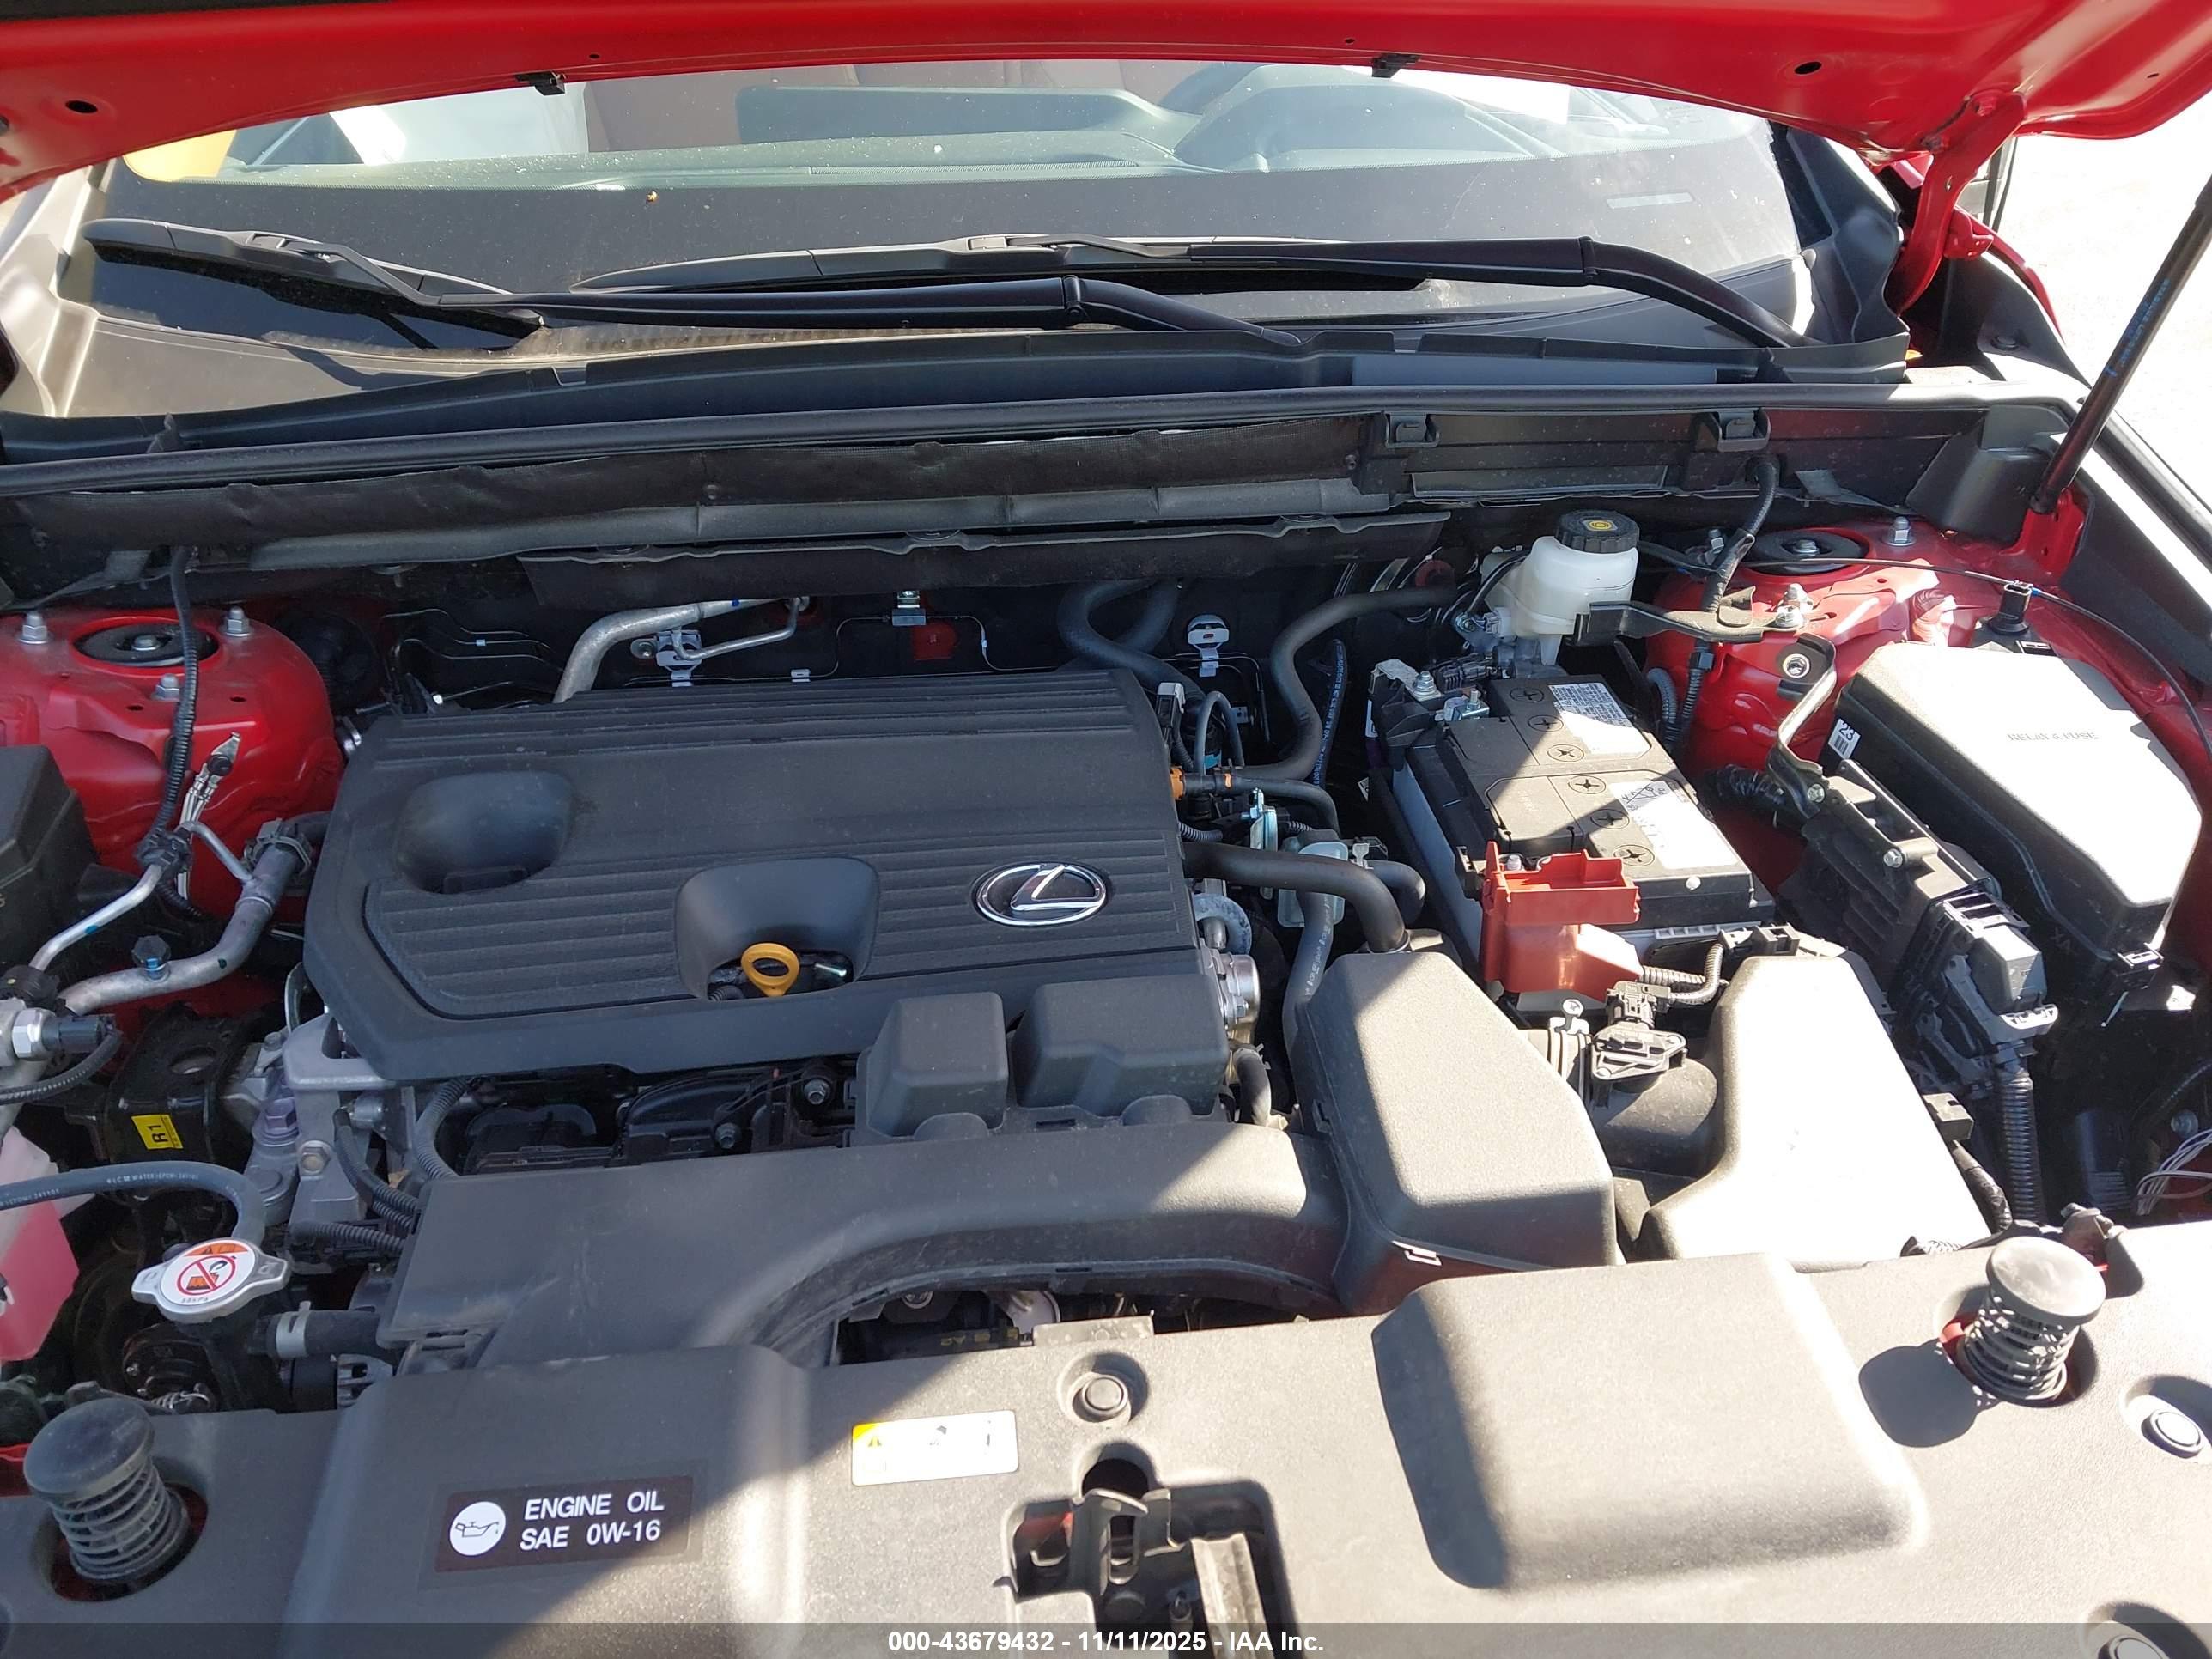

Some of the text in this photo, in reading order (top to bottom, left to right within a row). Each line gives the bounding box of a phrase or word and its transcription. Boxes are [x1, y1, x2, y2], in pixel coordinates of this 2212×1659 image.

[147, 1124, 169, 1143] R1
[525, 1490, 665, 1521] ENGINE OIL
[520, 1519, 661, 1551] SAE 0W-16
